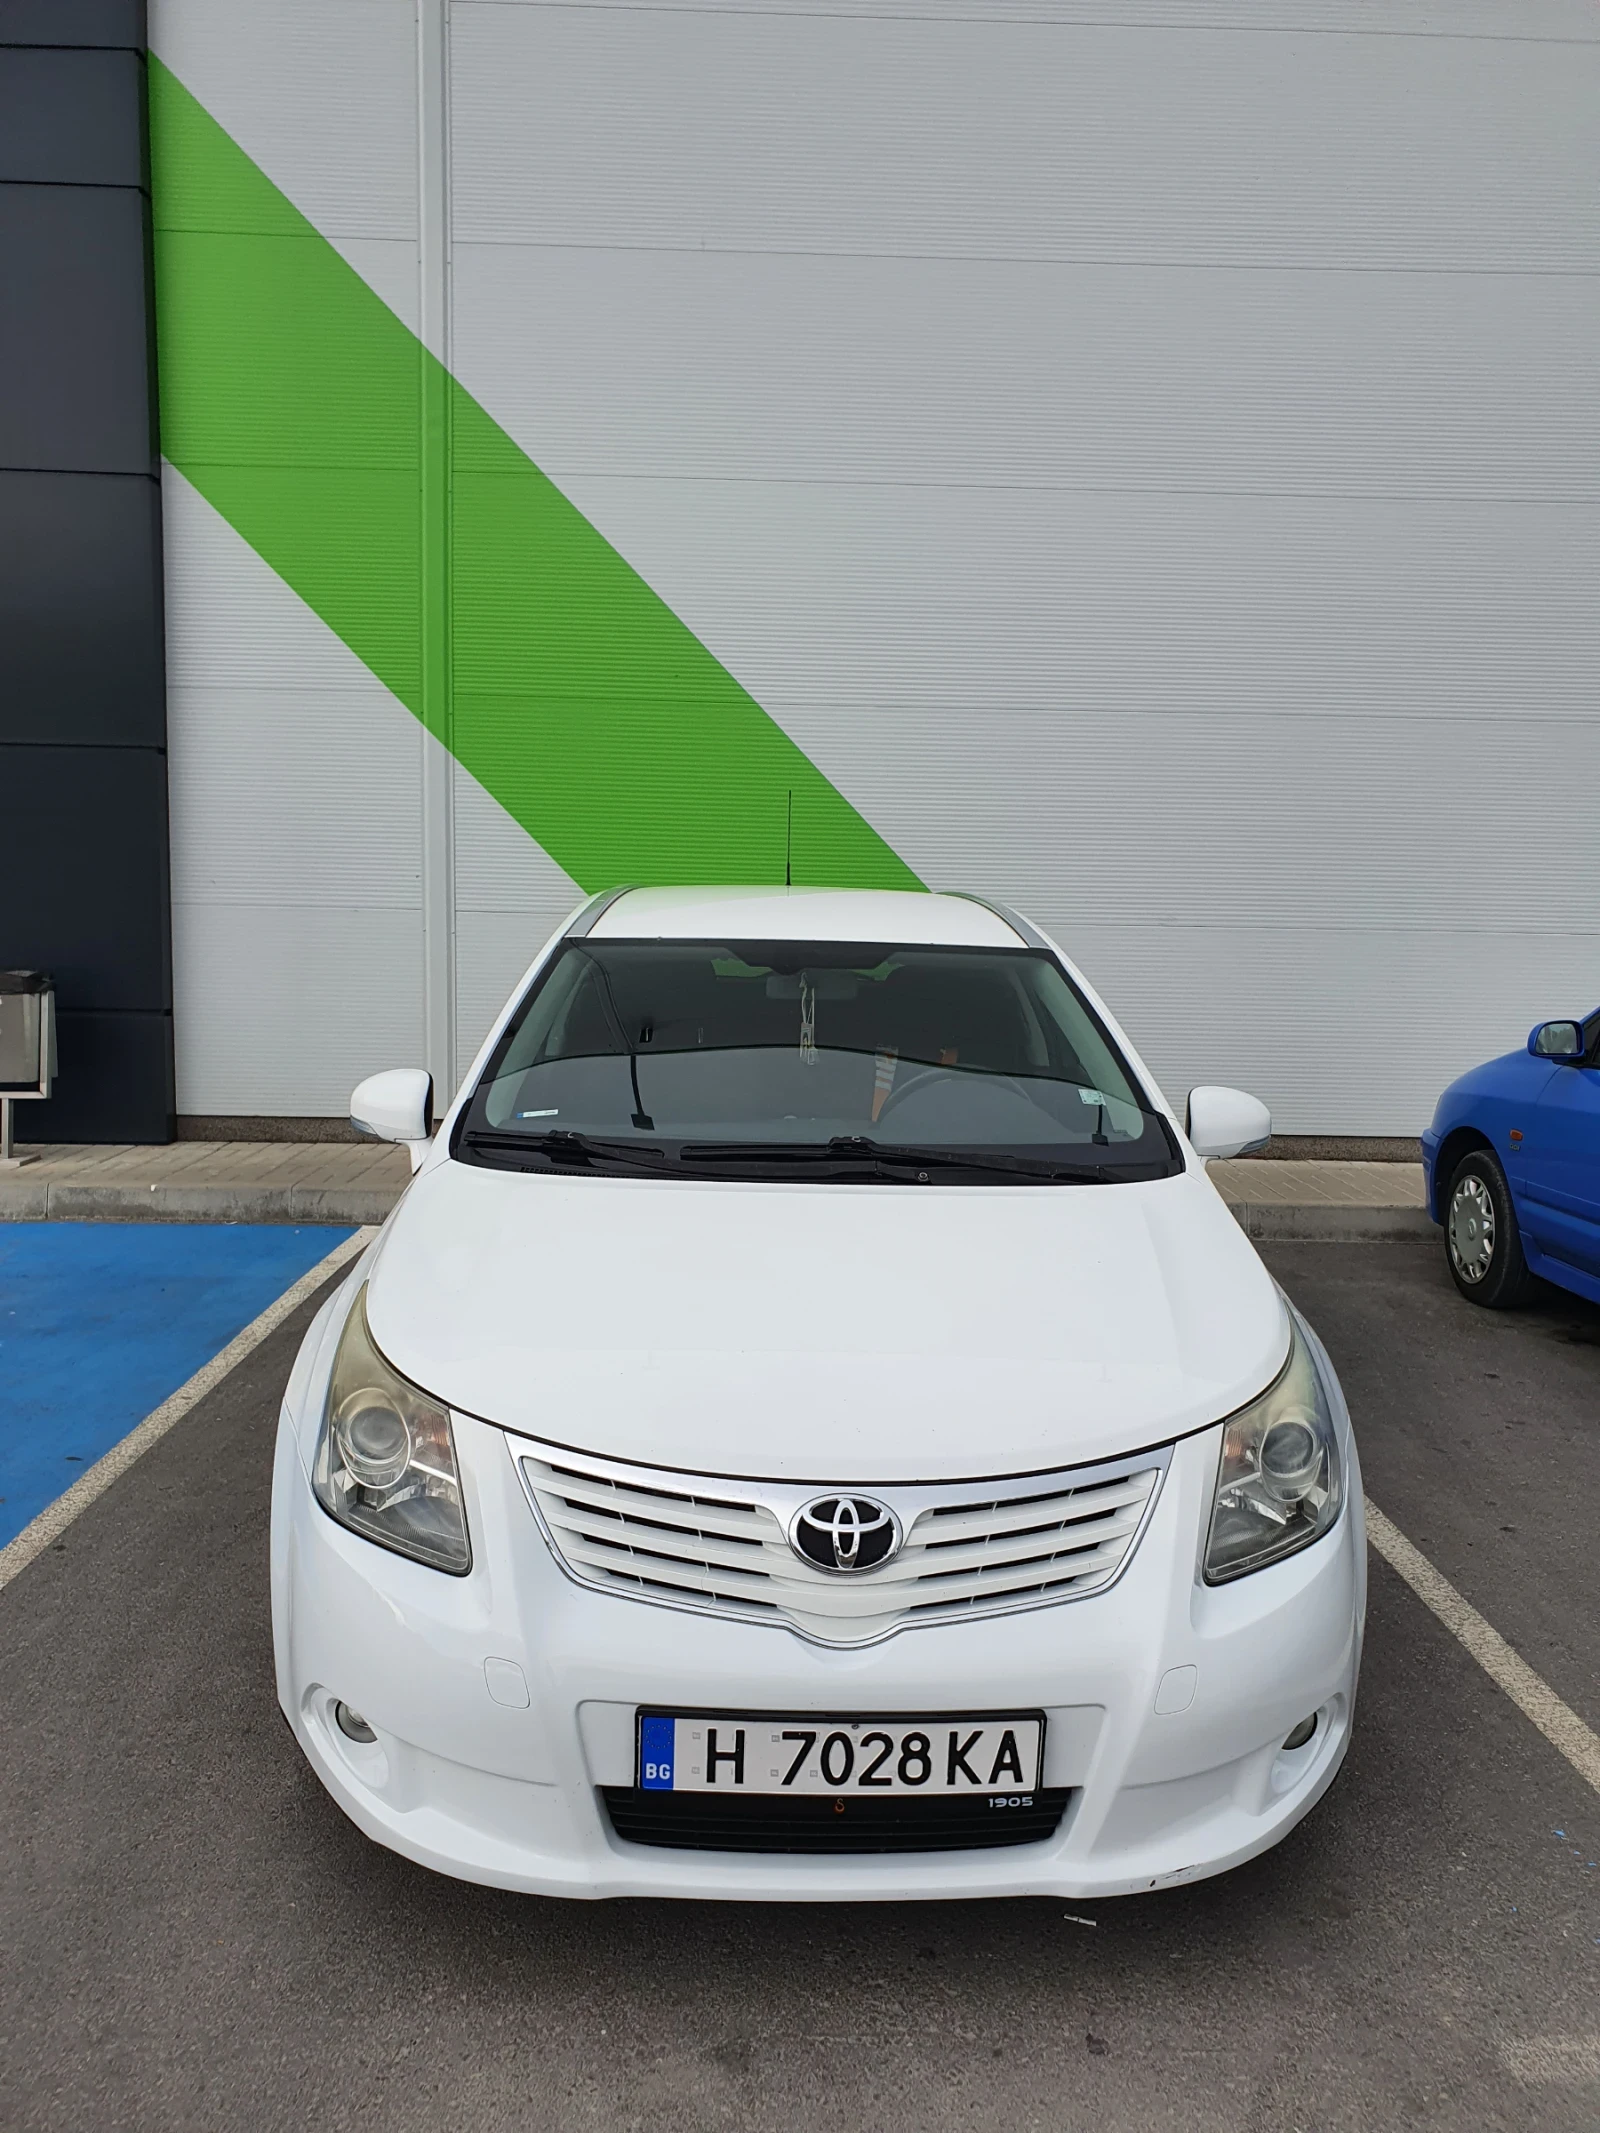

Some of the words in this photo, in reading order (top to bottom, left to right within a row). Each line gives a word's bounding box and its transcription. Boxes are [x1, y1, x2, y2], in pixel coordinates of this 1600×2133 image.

[706, 1728, 745, 1784] H
[645, 1762, 671, 1780] BG
[988, 1796, 1034, 1808] 1905
